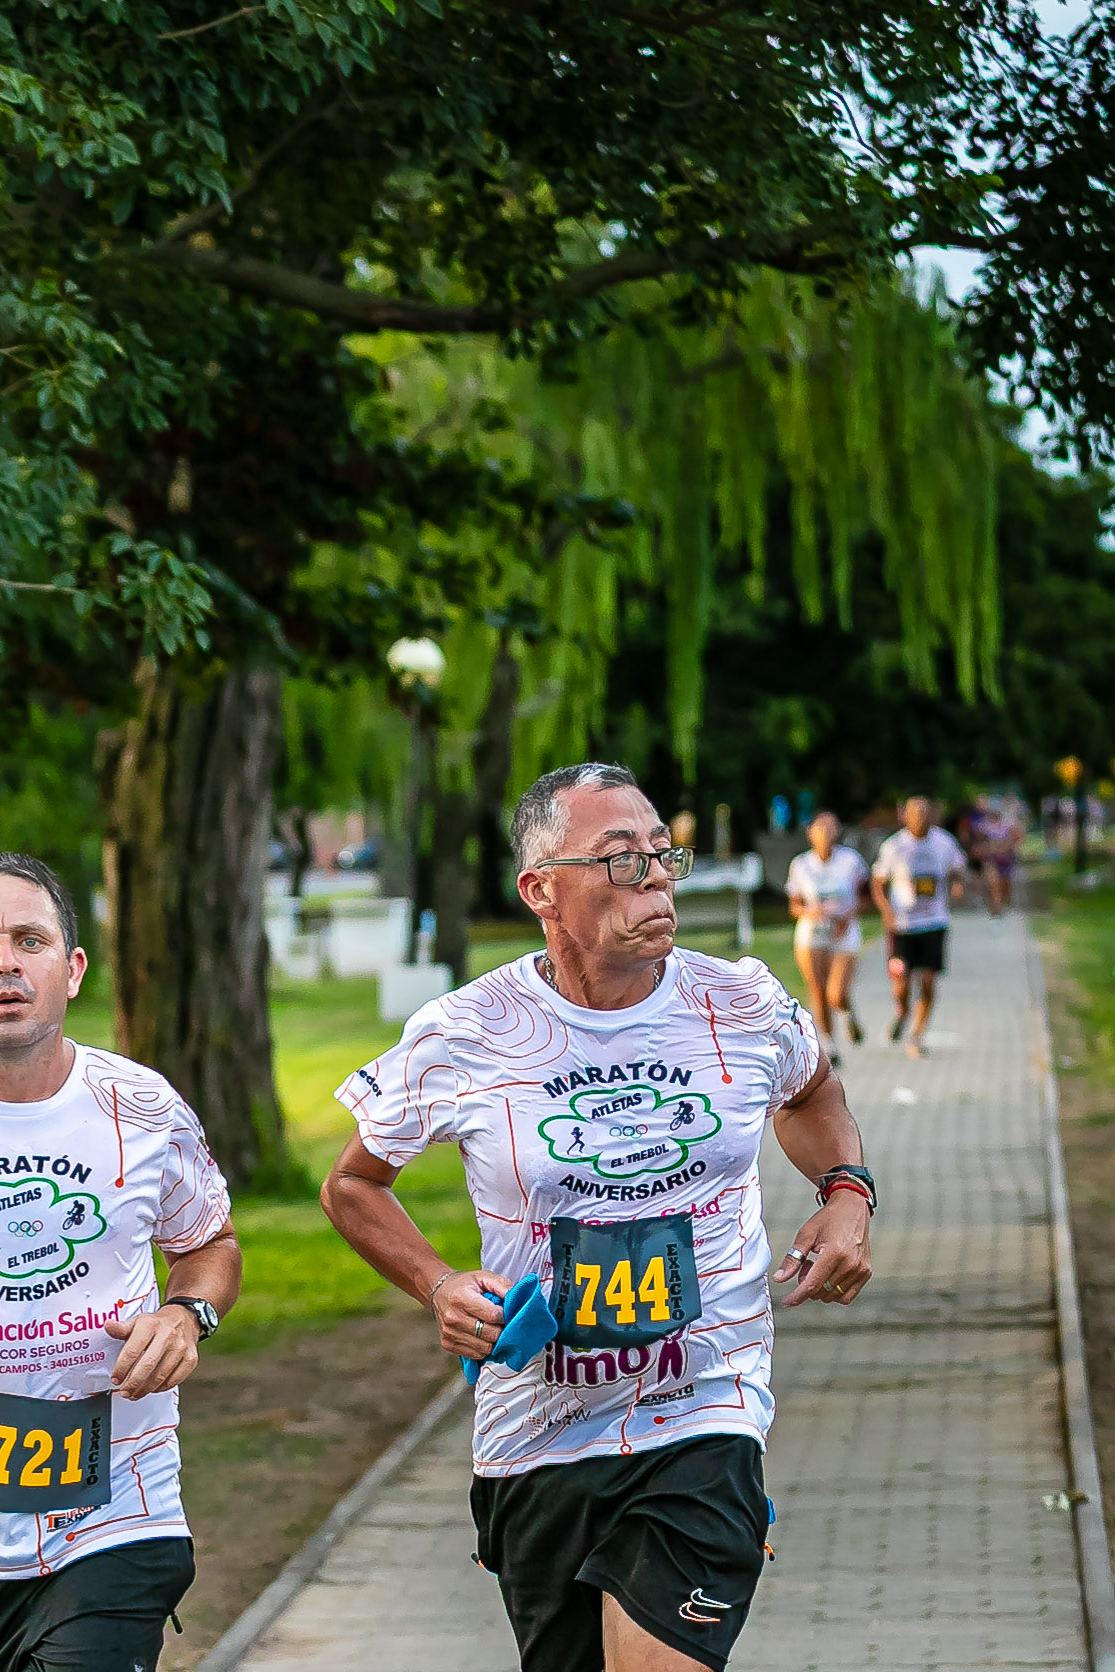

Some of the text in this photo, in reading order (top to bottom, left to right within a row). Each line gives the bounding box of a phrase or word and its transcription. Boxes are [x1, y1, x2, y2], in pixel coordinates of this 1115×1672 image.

[542, 1060, 692, 1099] MARATÓN
[591, 1093, 643, 1119] ATLETAS
[610, 1144, 670, 1169] EL TREBOL
[557, 1160, 707, 1202] ANIVERSARIO
[7, 1242, 60, 1269] EL TREBOL
[555, 1244, 576, 1321] TIEMPO
[575, 1256, 671, 1326] 744
[666, 1243, 686, 1322] EXACTO
[29, 1338, 90, 1358] SEGUROS
[86, 1416, 102, 1486] EXACTO
